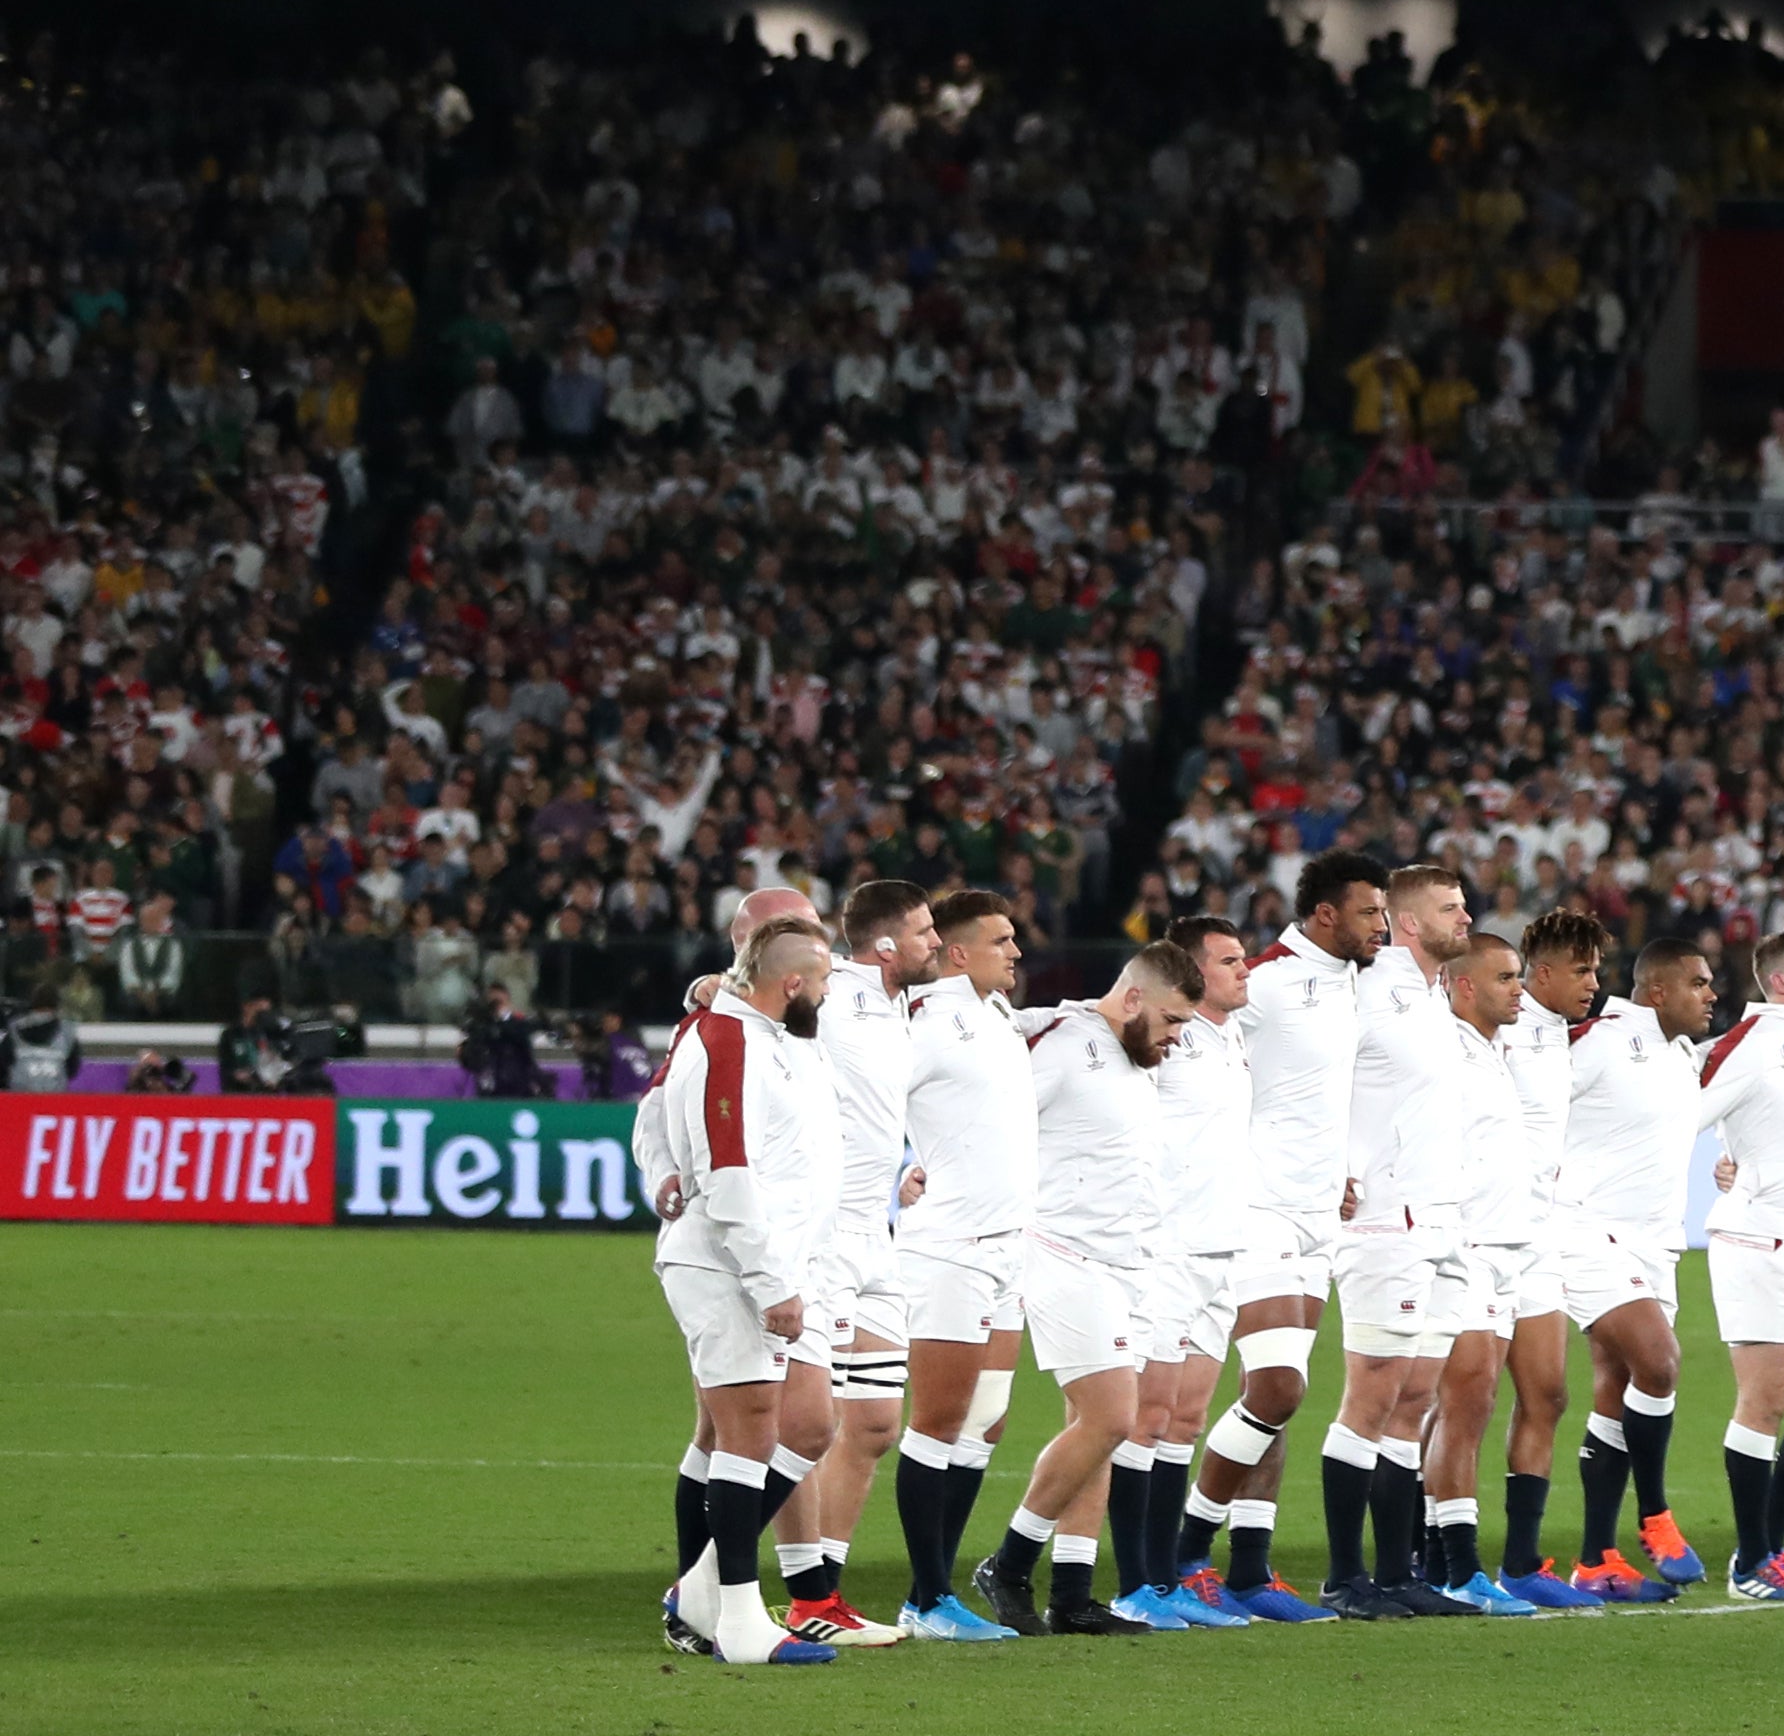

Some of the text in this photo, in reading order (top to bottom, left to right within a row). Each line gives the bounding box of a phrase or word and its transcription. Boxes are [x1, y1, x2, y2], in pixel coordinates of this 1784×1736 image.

[22, 1115, 317, 1205] FLY BETTER
[345, 1109, 655, 1221] Hein
